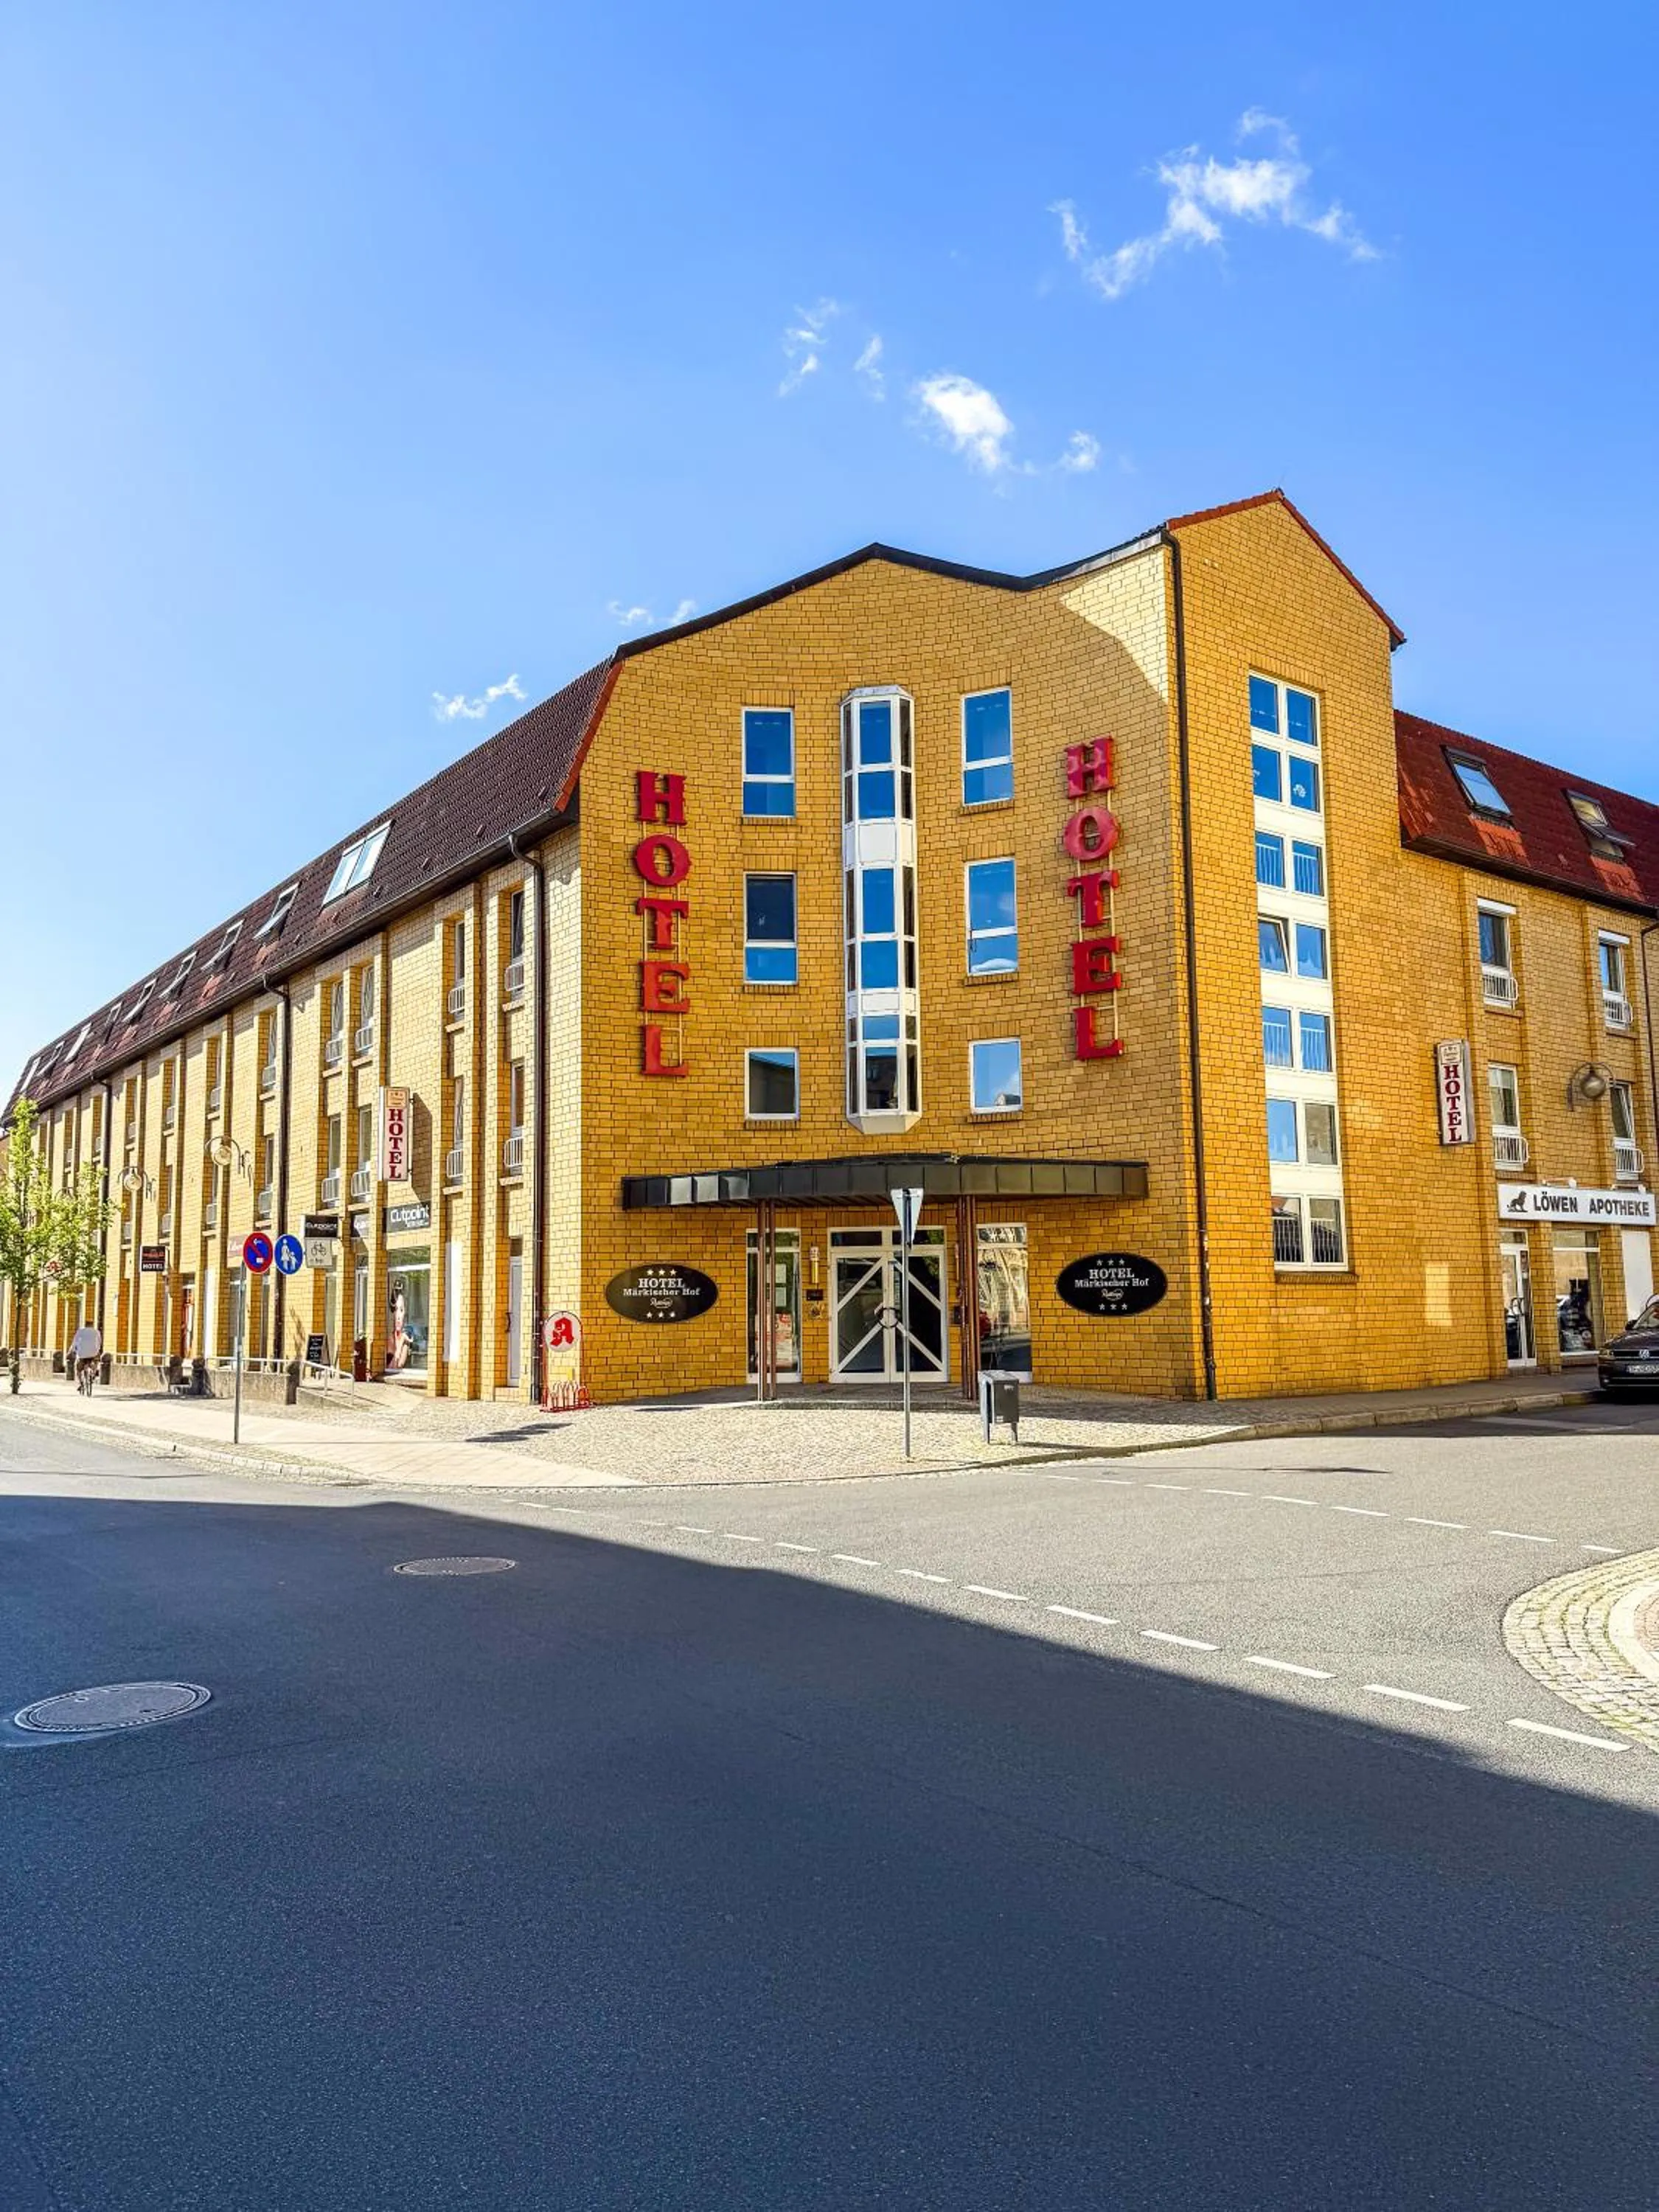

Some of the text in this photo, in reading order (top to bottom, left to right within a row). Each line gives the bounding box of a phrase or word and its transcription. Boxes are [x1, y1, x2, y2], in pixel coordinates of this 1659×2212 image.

[1063, 735, 1124, 1061] HOTEL
[633, 770, 692, 1079] HOTEL
[1443, 1064, 1461, 1142] HOTEL
[389, 1108, 403, 1179] HOTEL
[1533, 1191, 1649, 1217] LÖWEN APOTHEKE
[638, 1278, 685, 1288] HOTEL
[1074, 1278, 1150, 1288] Märkischer Hof
[1088, 1267, 1135, 1279] HOTEL
[622, 1287, 700, 1296] Märkischer Hof
